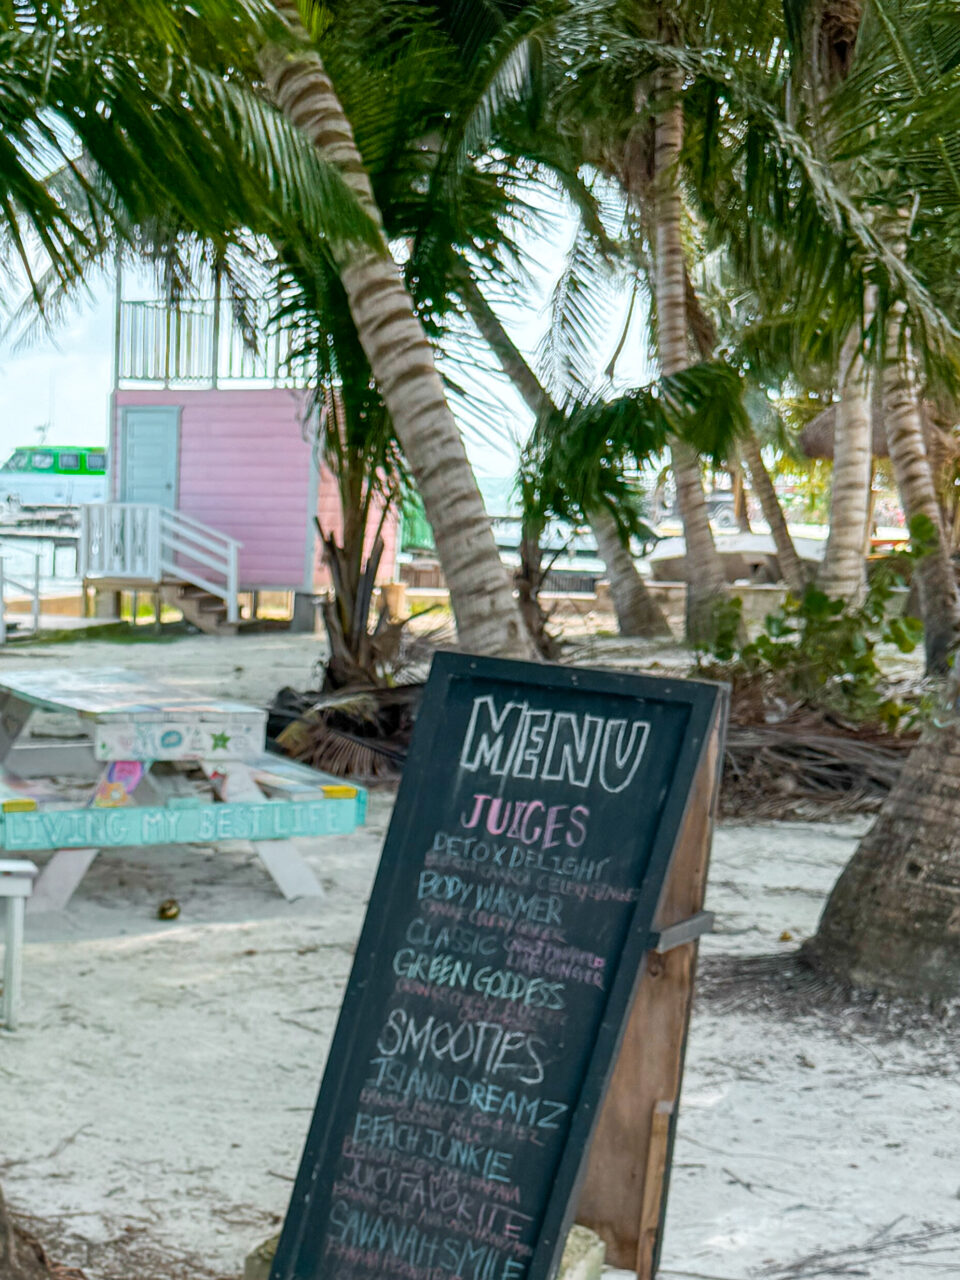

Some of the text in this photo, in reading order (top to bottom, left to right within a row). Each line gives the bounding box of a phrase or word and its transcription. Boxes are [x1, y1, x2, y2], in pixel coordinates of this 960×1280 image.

[460, 694, 651, 793] MENU
[8, 802, 340, 844] LIVING MY BEST LIFE
[460, 794, 590, 849] JUICES
[433, 832, 507, 867] DETOX
[508, 846, 611, 881] DELIGHT
[418, 870, 562, 927] BODY WARMER
[405, 918, 498, 956] CLASSIC
[393, 948, 566, 1010] GREEN GODDESS
[448, 1075, 569, 1130] DREAMZ
[352, 1112, 419, 1150] BEACH
[423, 1127, 513, 1184] JUNKIE
[397, 1172, 534, 1241] FAVORITE
